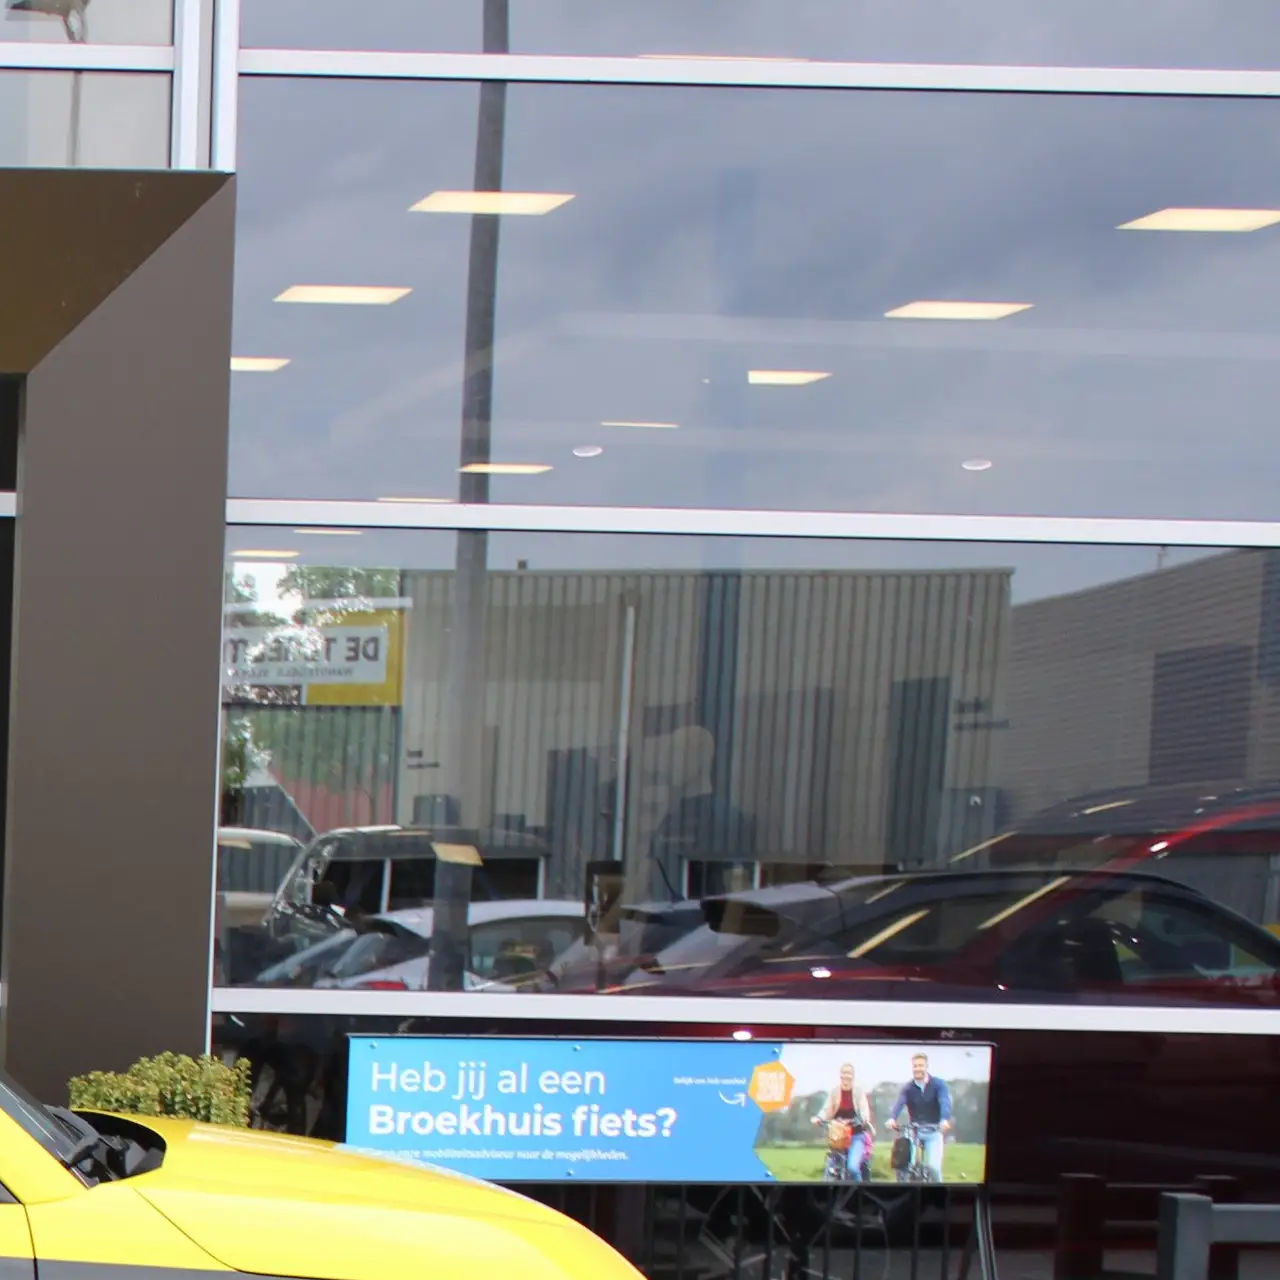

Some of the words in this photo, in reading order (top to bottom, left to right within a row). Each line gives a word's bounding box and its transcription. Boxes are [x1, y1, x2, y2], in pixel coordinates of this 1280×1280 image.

[370, 1060, 446, 1093] Heb
[451, 1060, 488, 1101] jij
[497, 1062, 529, 1094] al
[538, 1069, 606, 1095] een
[368, 1103, 562, 1136] Broekhuis
[571, 1104, 678, 1138] fiets?
